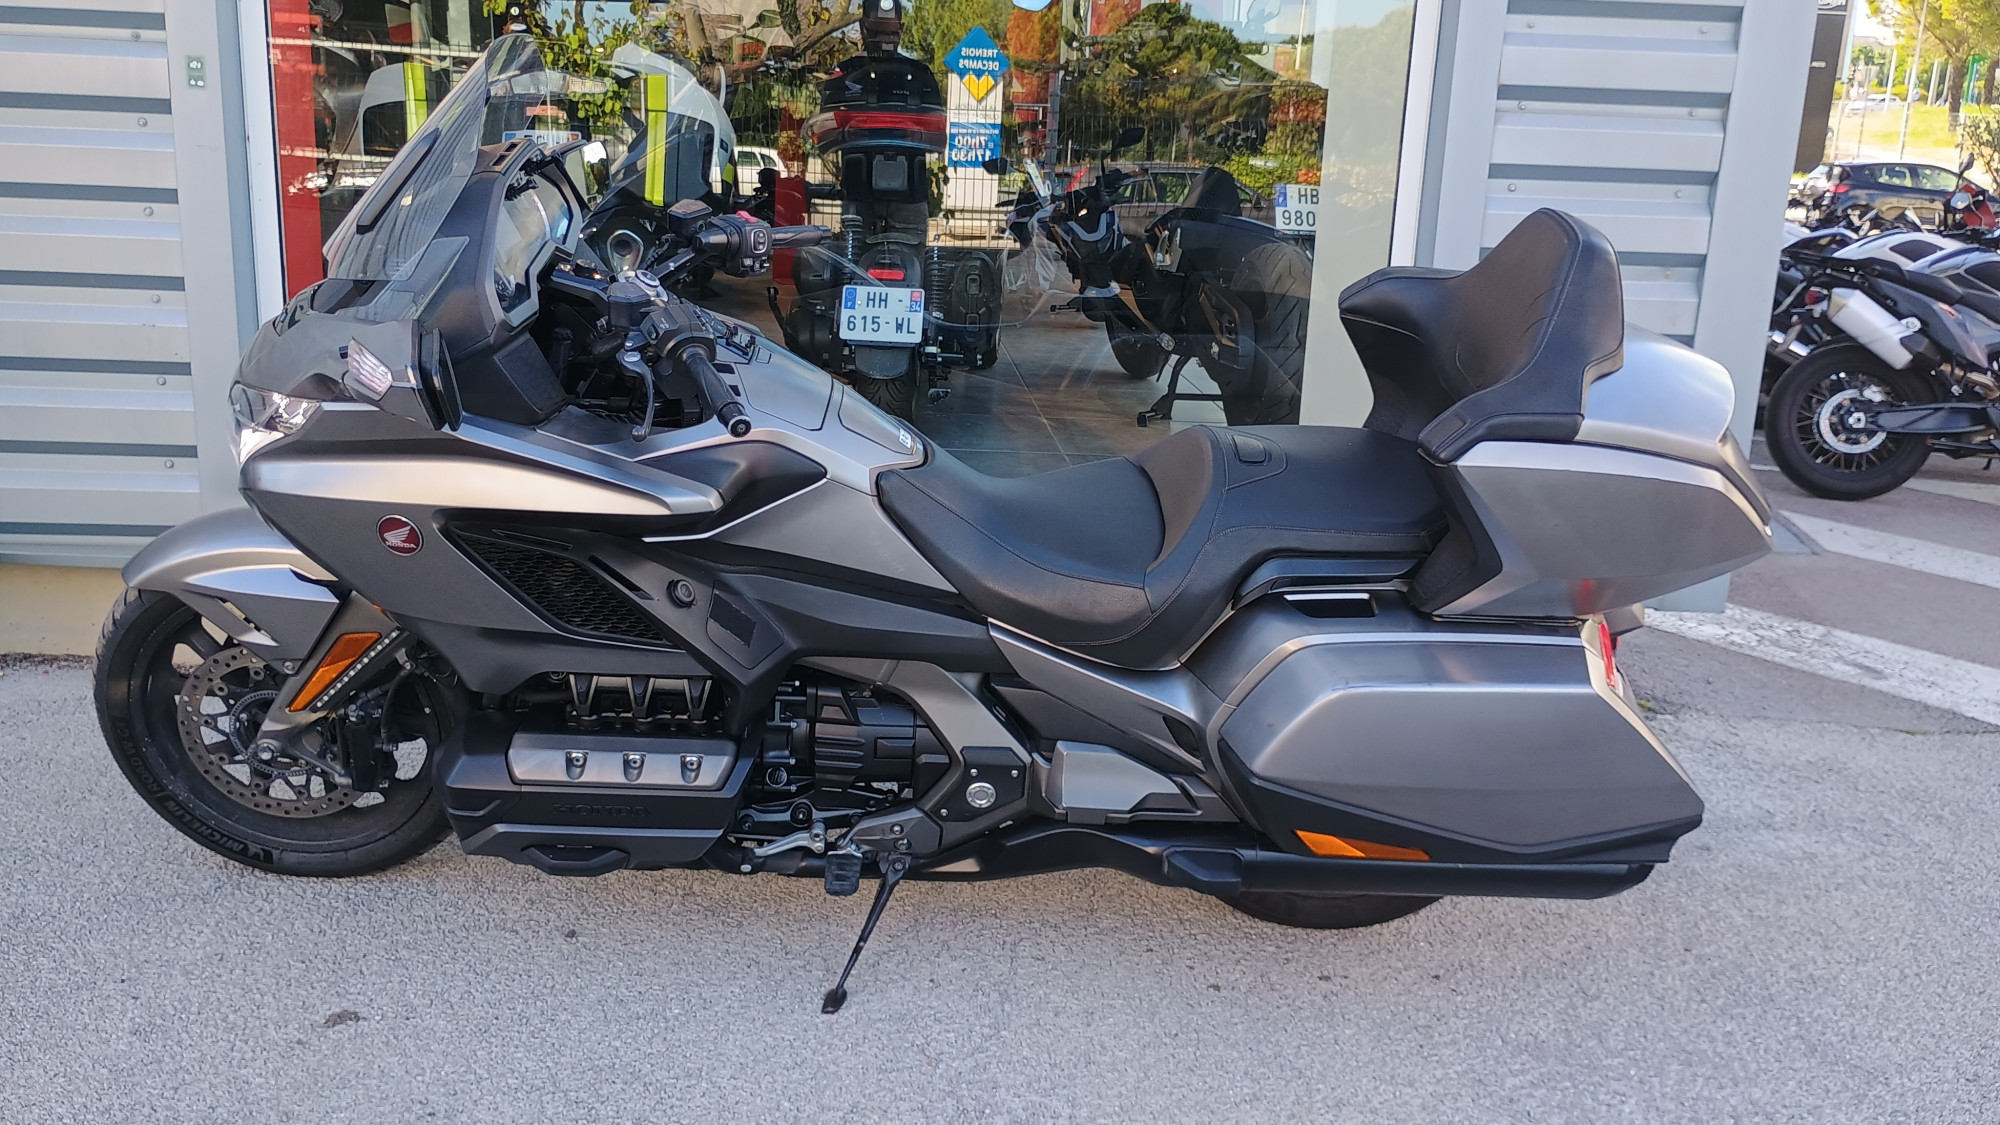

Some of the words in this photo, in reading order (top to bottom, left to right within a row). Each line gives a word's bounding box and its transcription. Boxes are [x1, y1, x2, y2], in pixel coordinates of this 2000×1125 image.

[1298, 188, 1319, 205] HB
[1282, 210, 1316, 227] 980
[910, 302, 920, 312] 34
[847, 315, 916, 334] 615-WL
[386, 540, 417, 549] HONDA
[164, 800, 246, 853] MICHELIN
